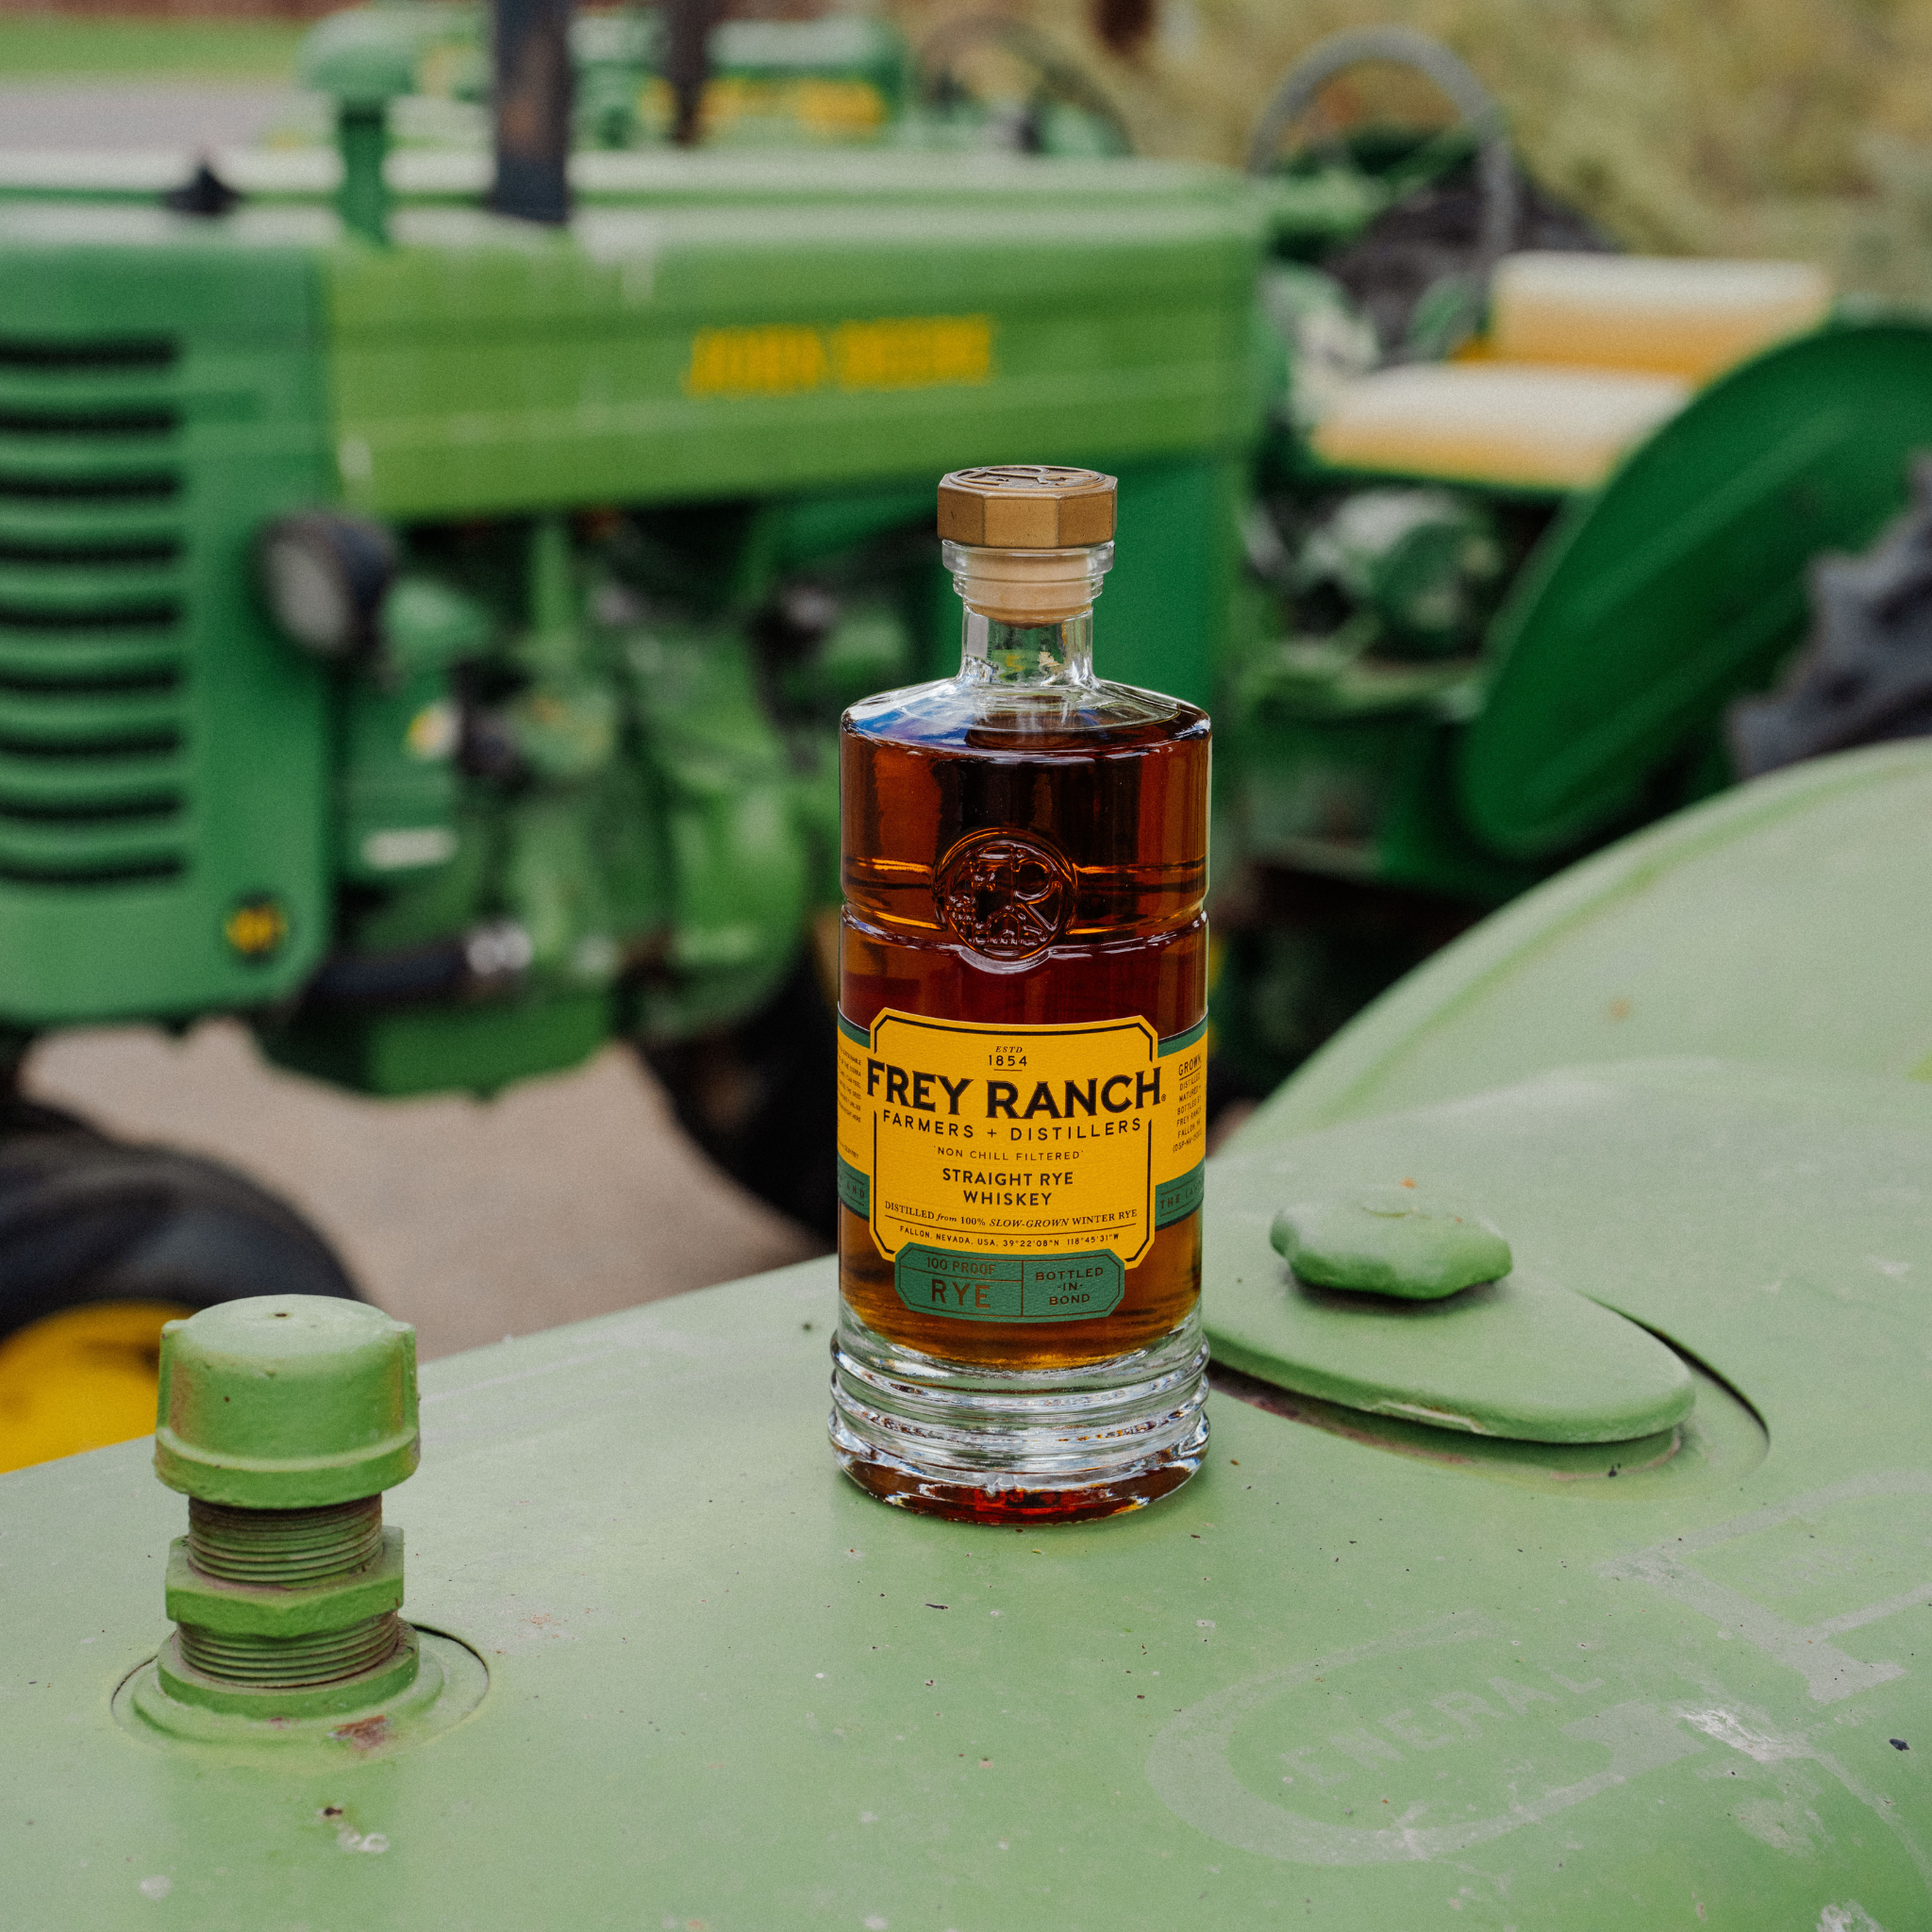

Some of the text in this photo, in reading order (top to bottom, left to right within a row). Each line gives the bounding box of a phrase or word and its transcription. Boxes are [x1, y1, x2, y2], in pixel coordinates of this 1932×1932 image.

[995, 1045, 1024, 1054] ESTD
[988, 1055, 1027, 1067] 1854
[1178, 1053, 1202, 1076] GROWN
[867, 1057, 974, 1116] FREY
[883, 1108, 974, 1139] FARMERS
[1010, 1118, 1141, 1141] DISTILLERS
[937, 1146, 1080, 1161] NON CHILL FILTERED
[942, 1168, 1074, 1186] STRAIGHT RYE
[963, 1190, 1053, 1206] WHISKEY
[1160, 1192, 1180, 1209] THE
[885, 1200, 1138, 1228] DISTILLED from 100% SLOW-GROWN WINTER RYE
[926, 1257, 996, 1275] 100 PROOF
[1036, 1267, 1104, 1281] BOTTLED
[931, 1278, 991, 1309] RYE
[1049, 1293, 1091, 1306] BOND
